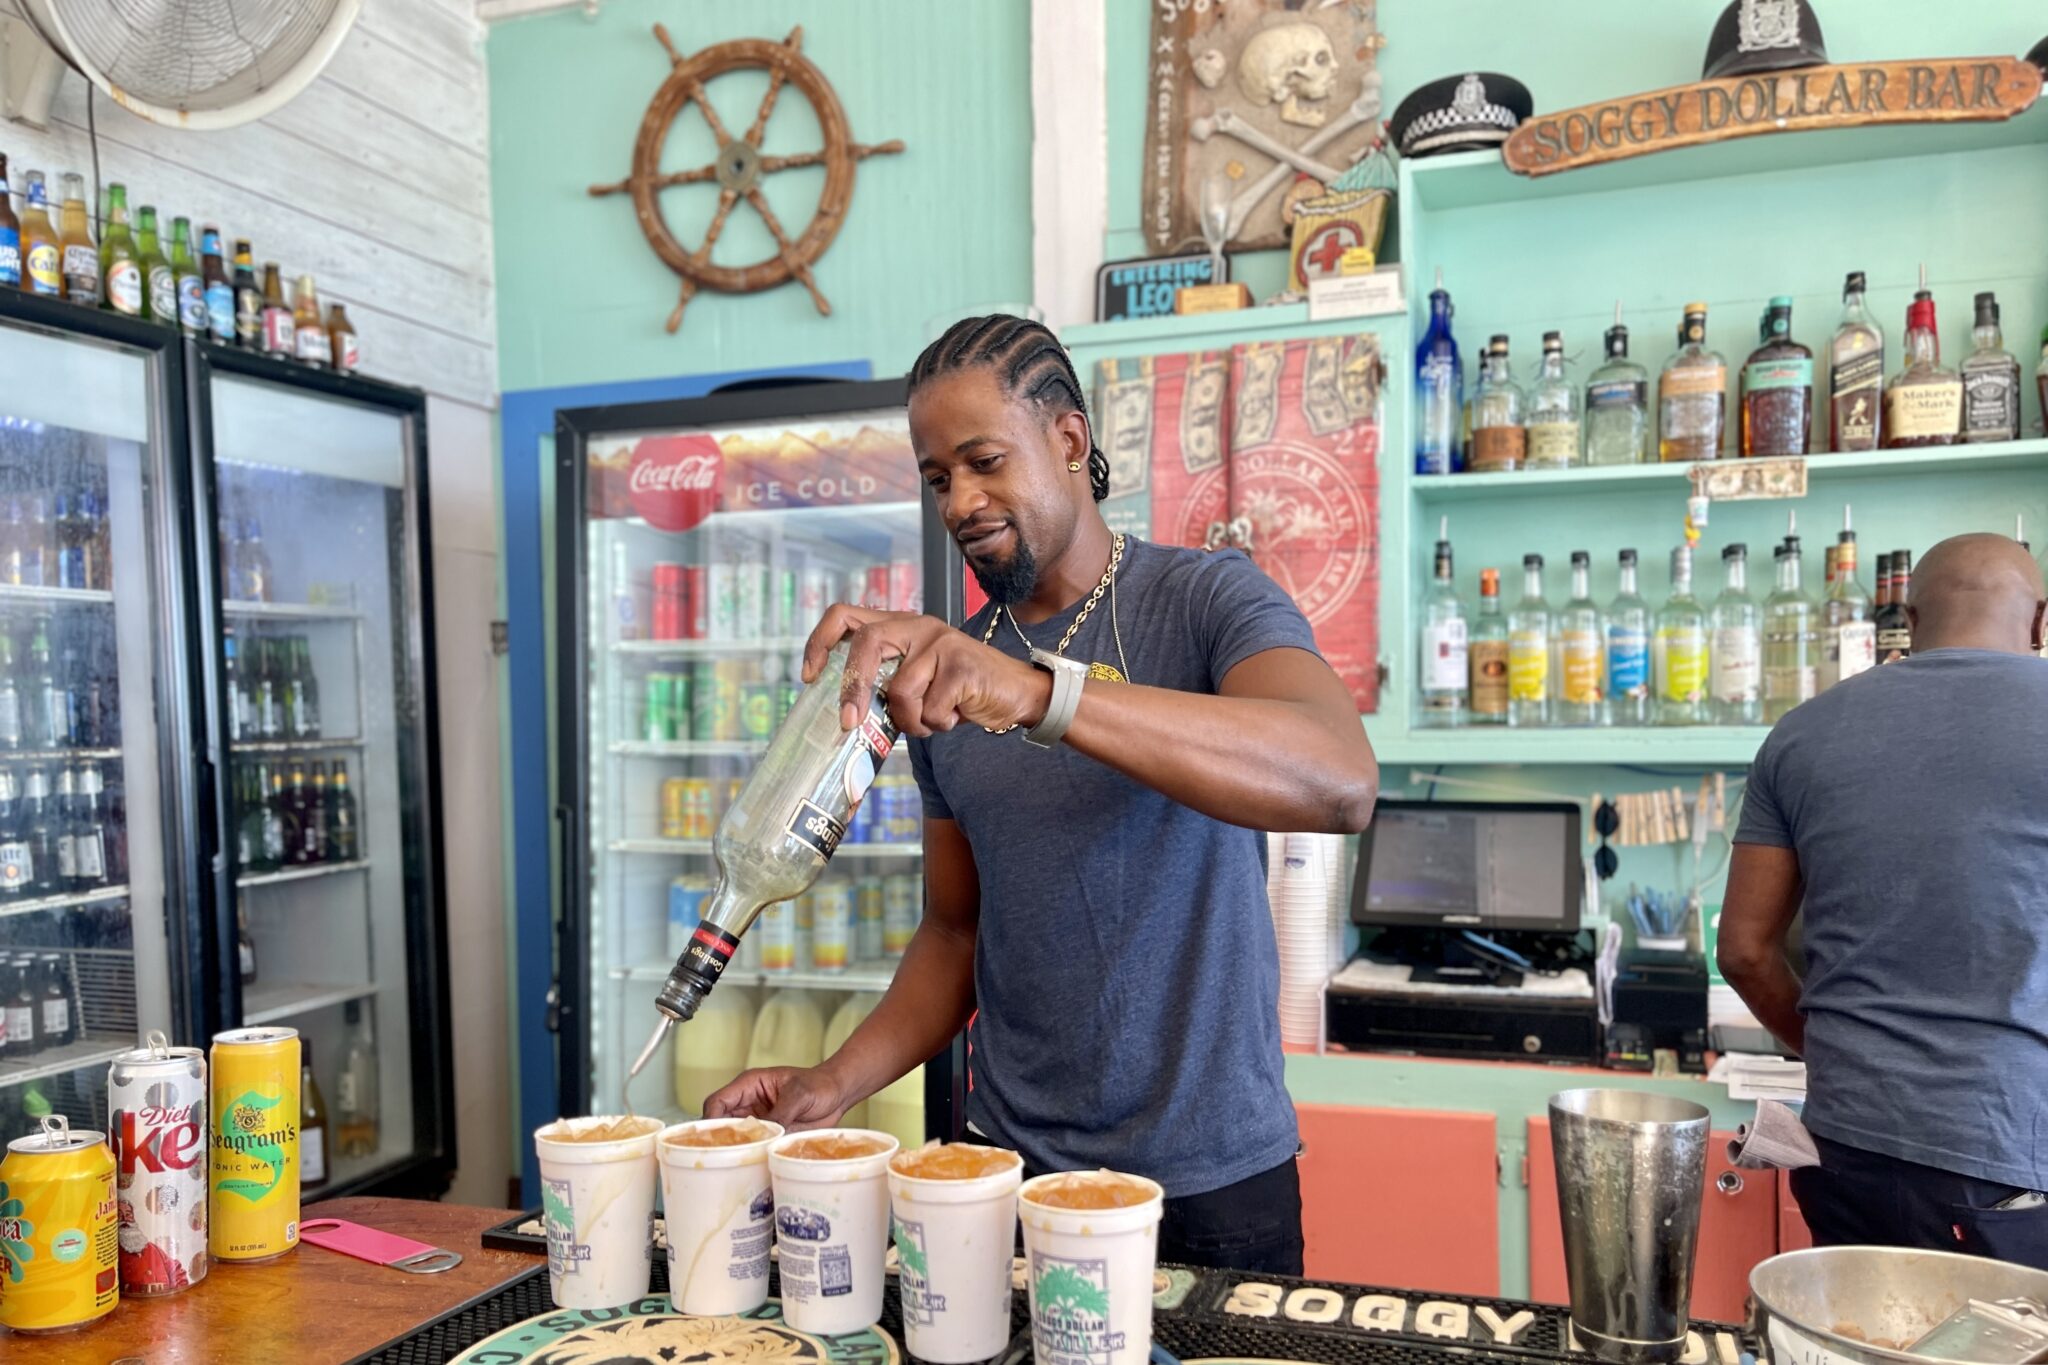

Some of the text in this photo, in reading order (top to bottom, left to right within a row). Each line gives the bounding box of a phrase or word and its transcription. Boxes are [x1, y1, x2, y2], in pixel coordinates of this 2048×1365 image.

[1157, 36, 1175, 53] X
[1532, 62, 2004, 165] SOGGY DOLLAR BAR
[1110, 258, 1213, 287] ENTERING
[630, 454, 720, 494] Coca-Cola
[734, 475, 878, 503] ICE COLD
[867, 725, 887, 750] SEAL
[691, 946, 724, 972] Goslings
[139, 1104, 190, 1126] Diet
[121, 1112, 201, 1173] ke
[251, 1157, 291, 1171] WATER
[1066, 1318, 1104, 1332] DOLLAR
[1224, 1282, 1535, 1344] SOGGY
